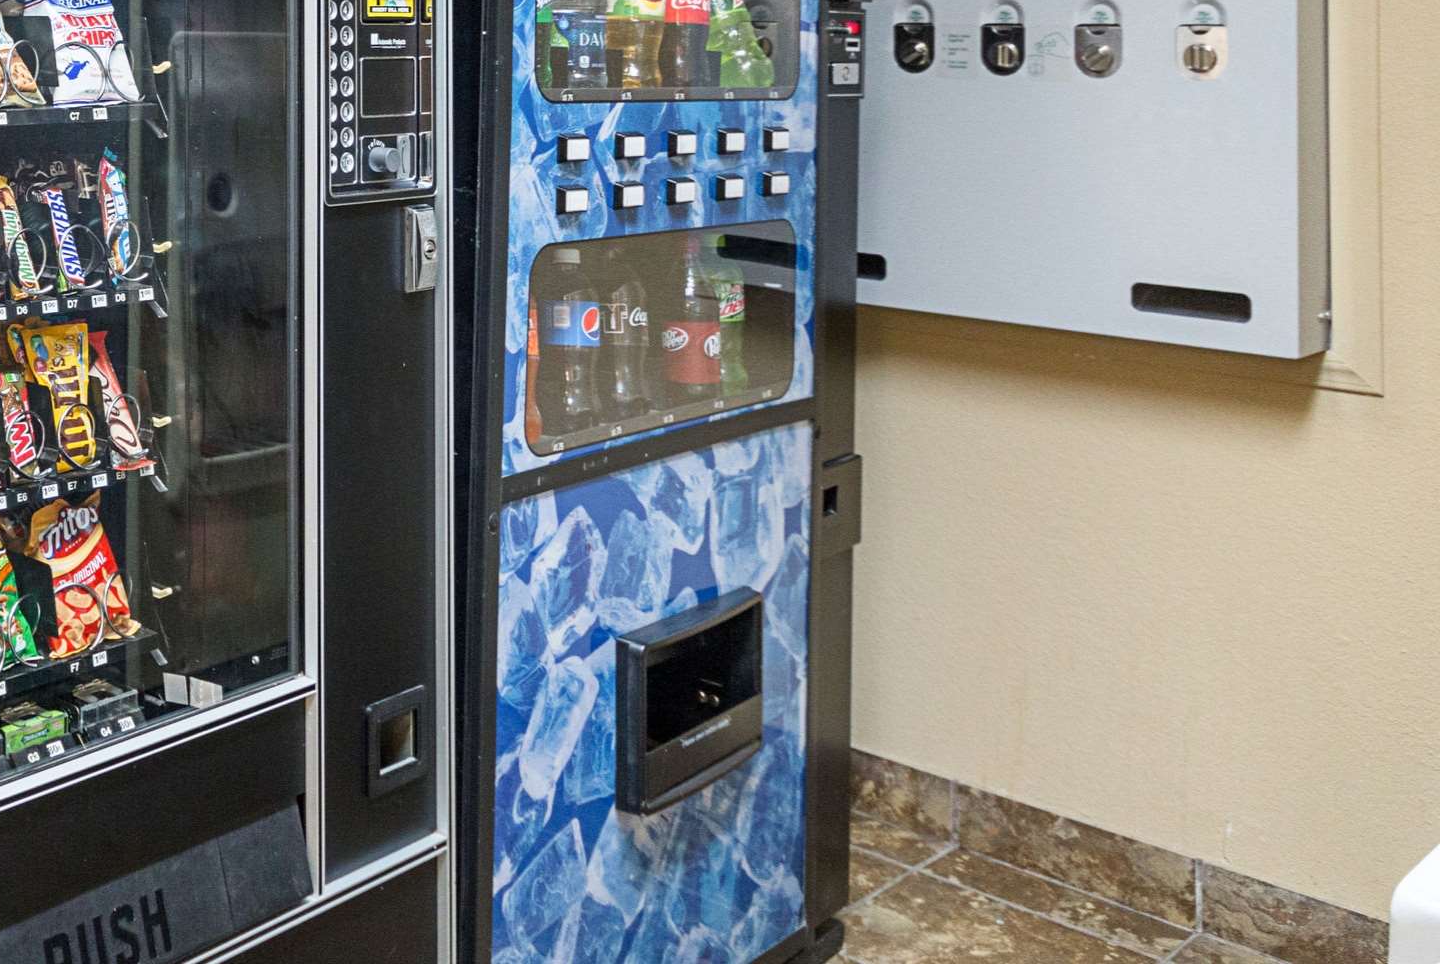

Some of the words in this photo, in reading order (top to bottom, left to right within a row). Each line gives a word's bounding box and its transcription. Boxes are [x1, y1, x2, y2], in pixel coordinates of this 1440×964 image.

[70, 111, 80, 120] C7
[367, 138, 386, 150] return
[14, 239, 37, 283] Milky
[67, 300, 77, 308] D7
[16, 306, 28, 315] D6
[67, 481, 78, 490] E7
[17, 493, 28, 502] E6
[39, 505, 99, 560] Fritos
[73, 551, 107, 584] ORIGINAL
[70, 662, 80, 672] F7
[100, 726, 112, 736] G4
[27, 751, 40, 763] G3
